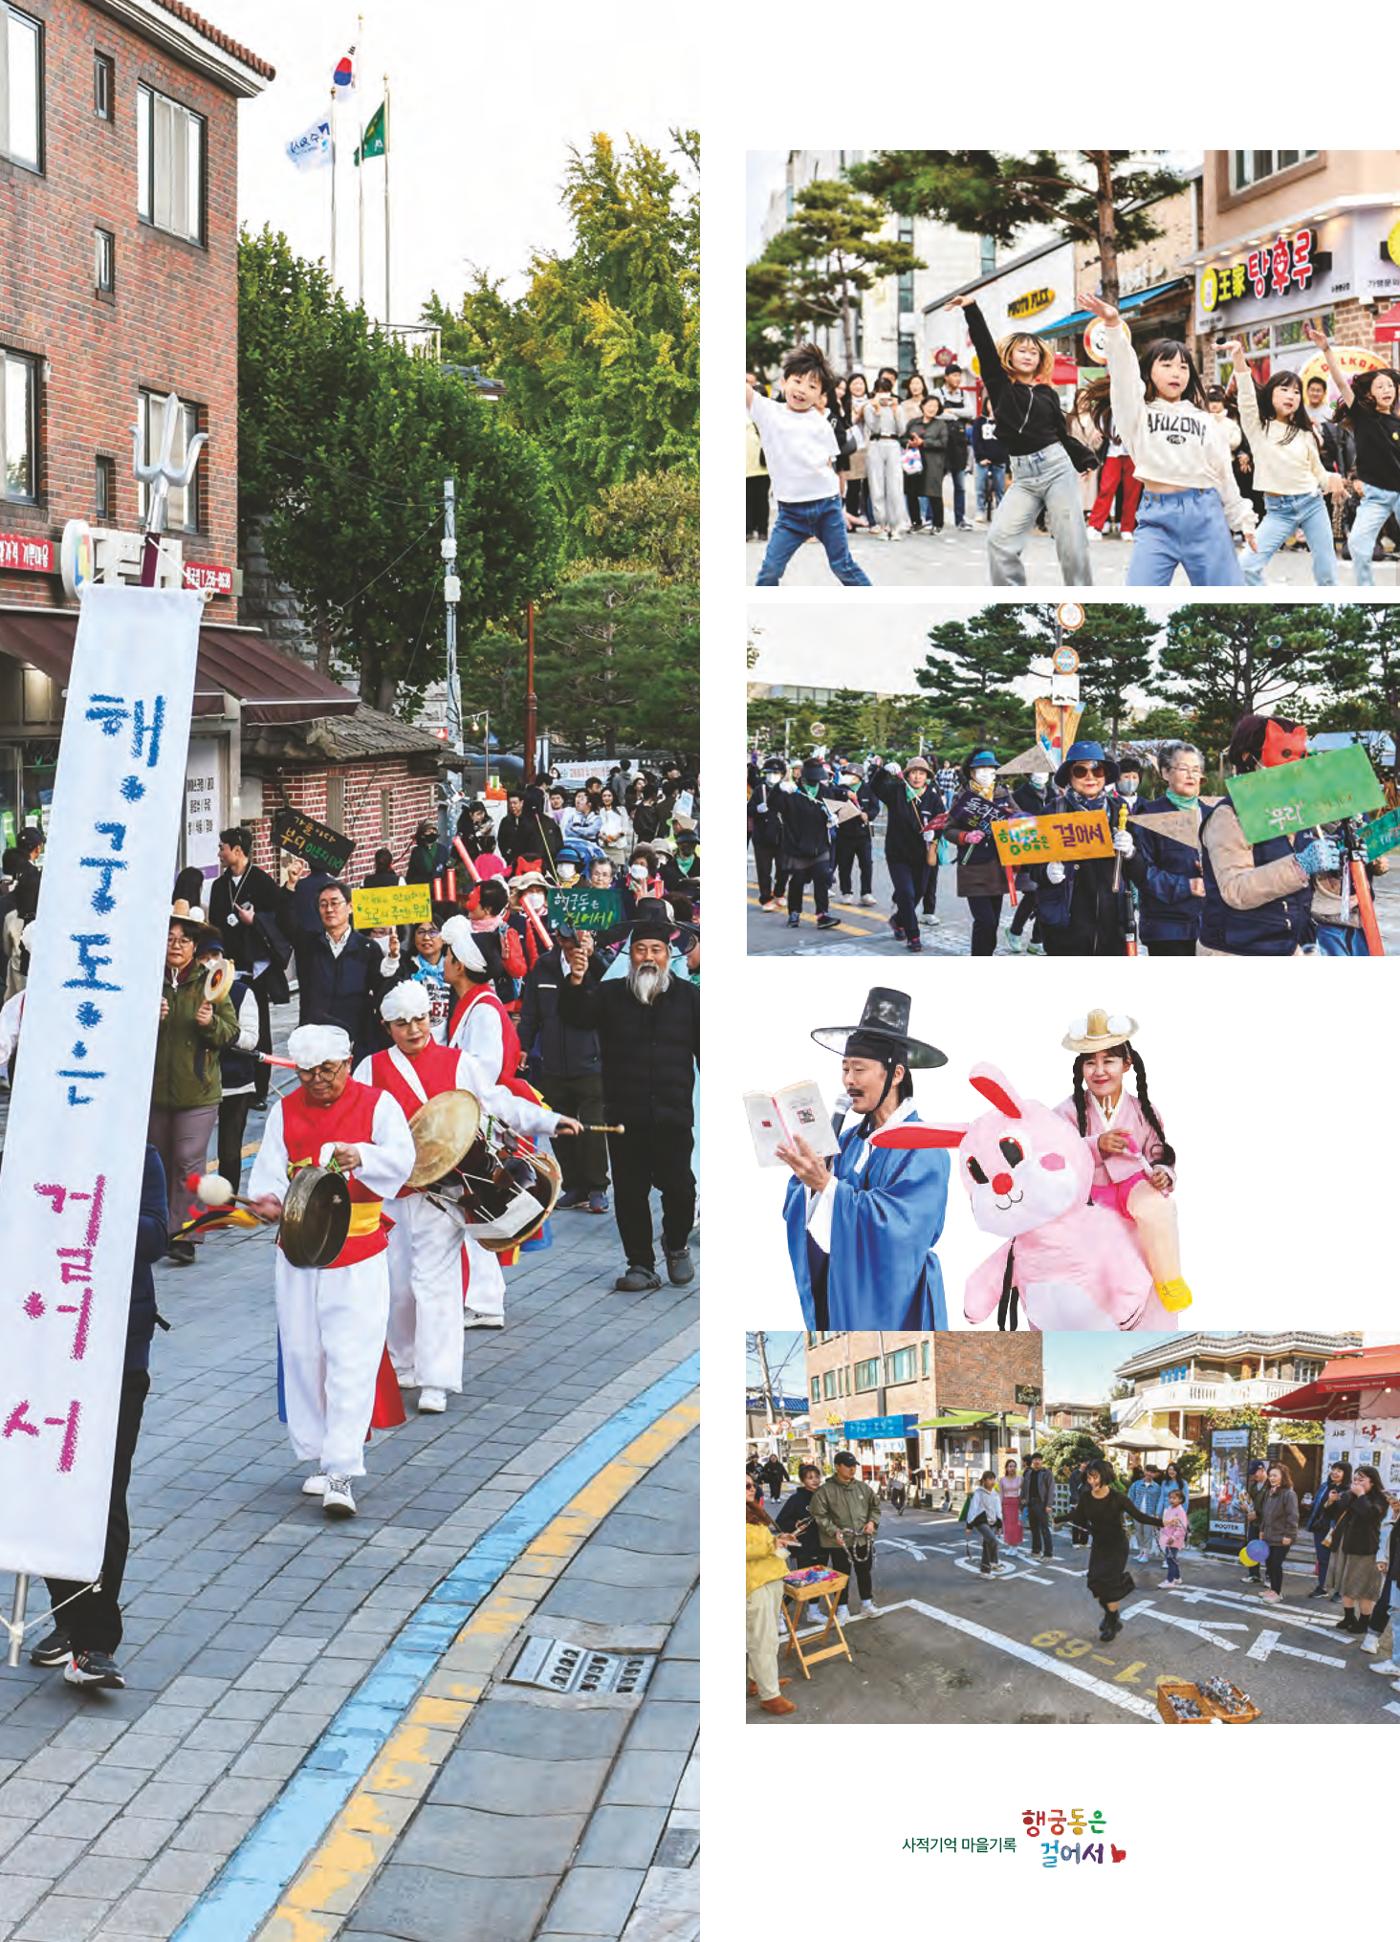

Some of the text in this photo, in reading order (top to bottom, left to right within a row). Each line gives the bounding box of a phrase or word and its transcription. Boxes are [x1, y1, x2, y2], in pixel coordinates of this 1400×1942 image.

[1244, 227, 1314, 300] 탕후루
[57, 693, 168, 1106] 행궁동은
[1053, 822, 1105, 848] 걸어서
[2, 1173, 107, 1473] 걸어서
